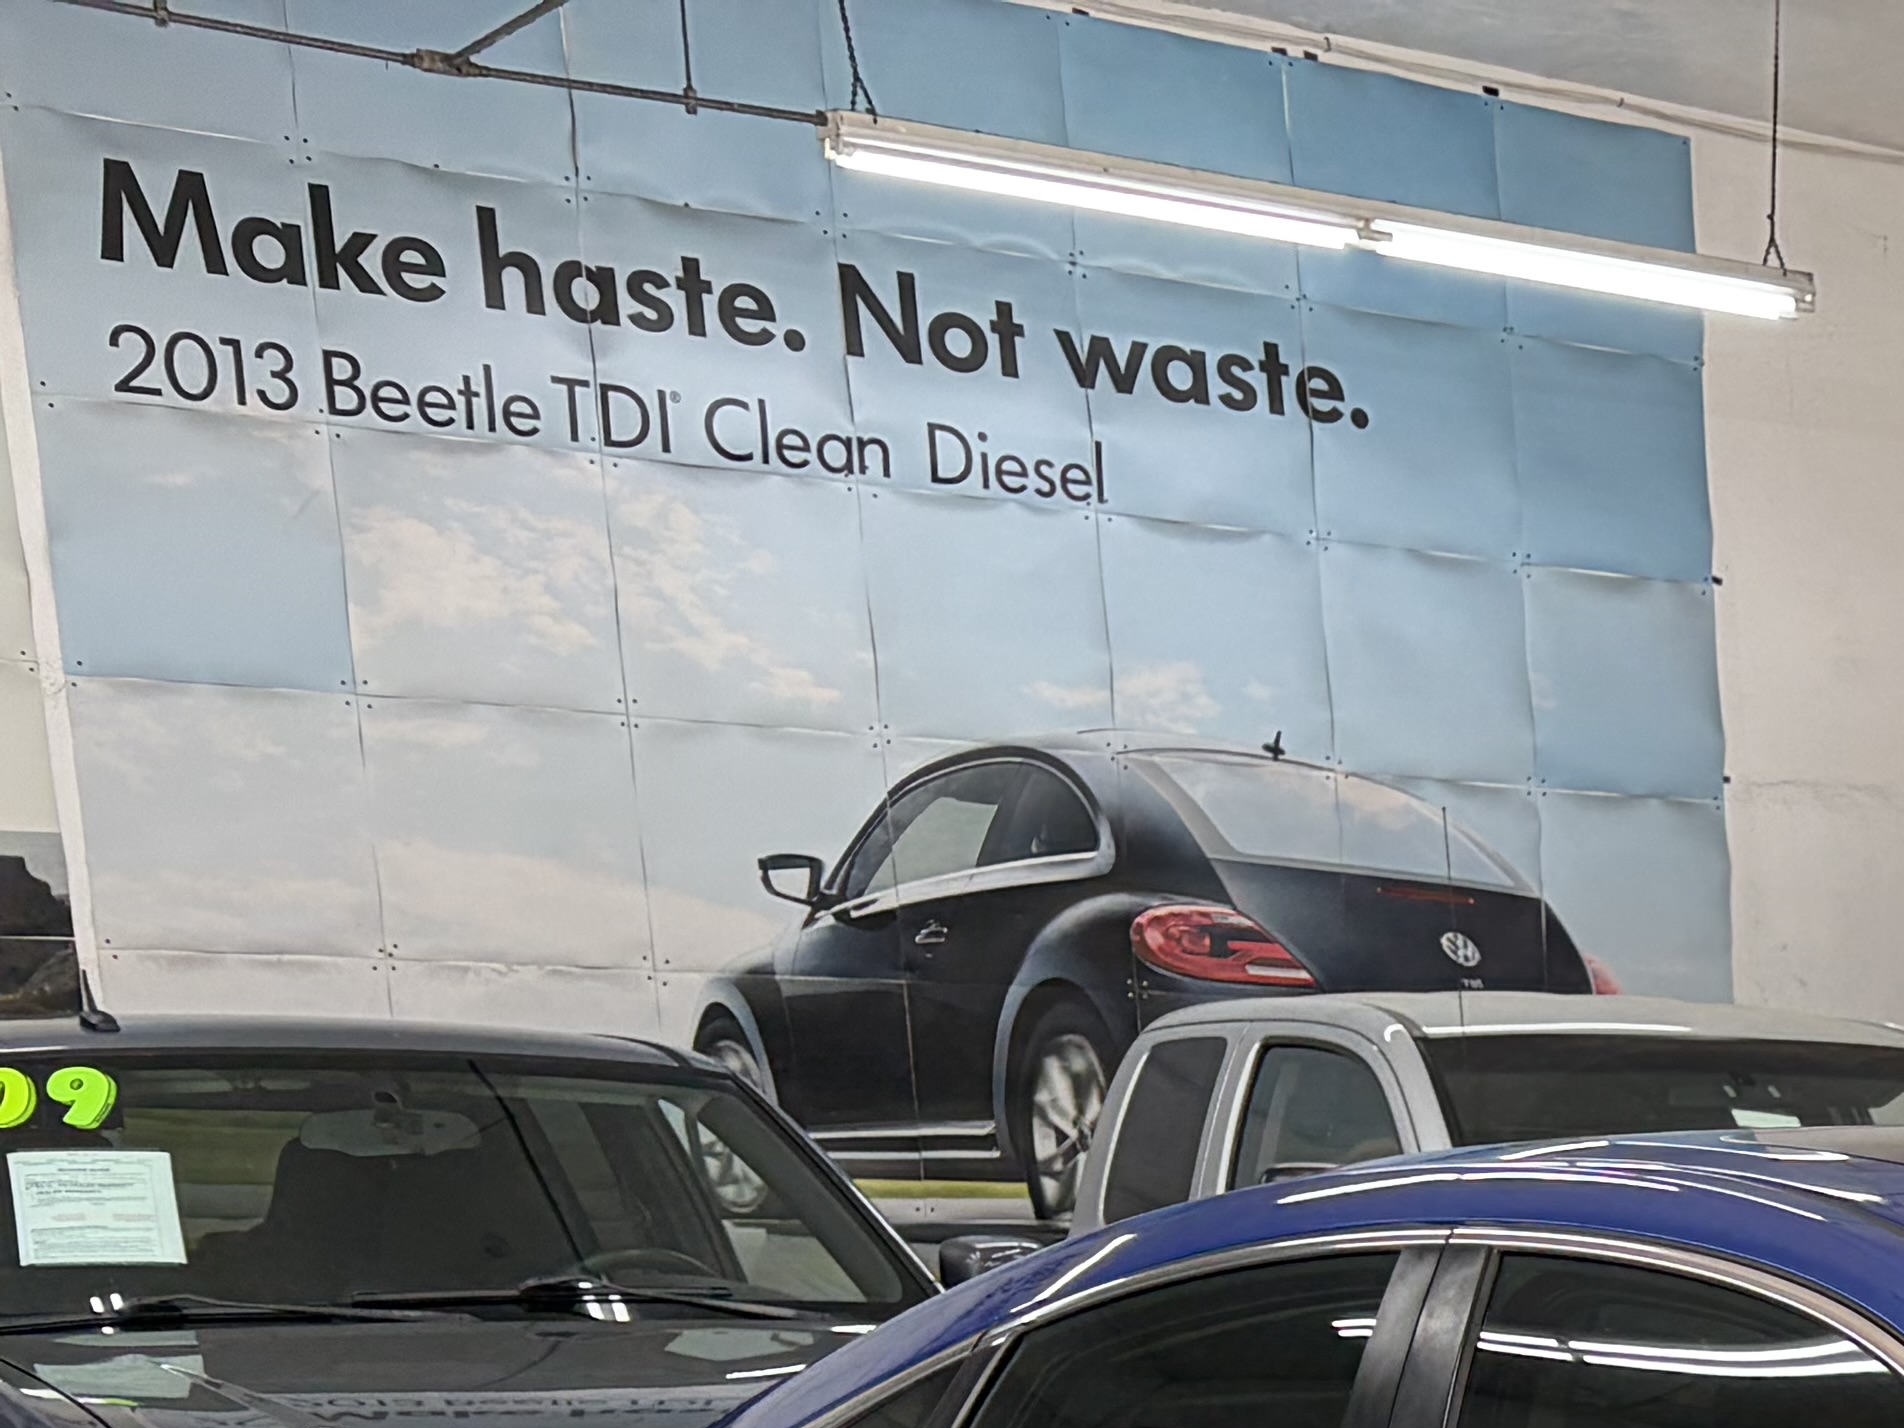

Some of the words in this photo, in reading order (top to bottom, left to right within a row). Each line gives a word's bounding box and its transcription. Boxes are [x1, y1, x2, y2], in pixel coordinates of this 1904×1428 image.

[101, 157, 447, 303] Make
[476, 204, 806, 352] haste.
[837, 262, 1025, 380] Not
[1053, 326, 1370, 430] waste.
[108, 323, 300, 411] 2013
[321, 348, 542, 437] Beetle
[704, 397, 891, 477] Clean
[927, 421, 1108, 504] Diesel
[0, 1066, 118, 1130] 09
